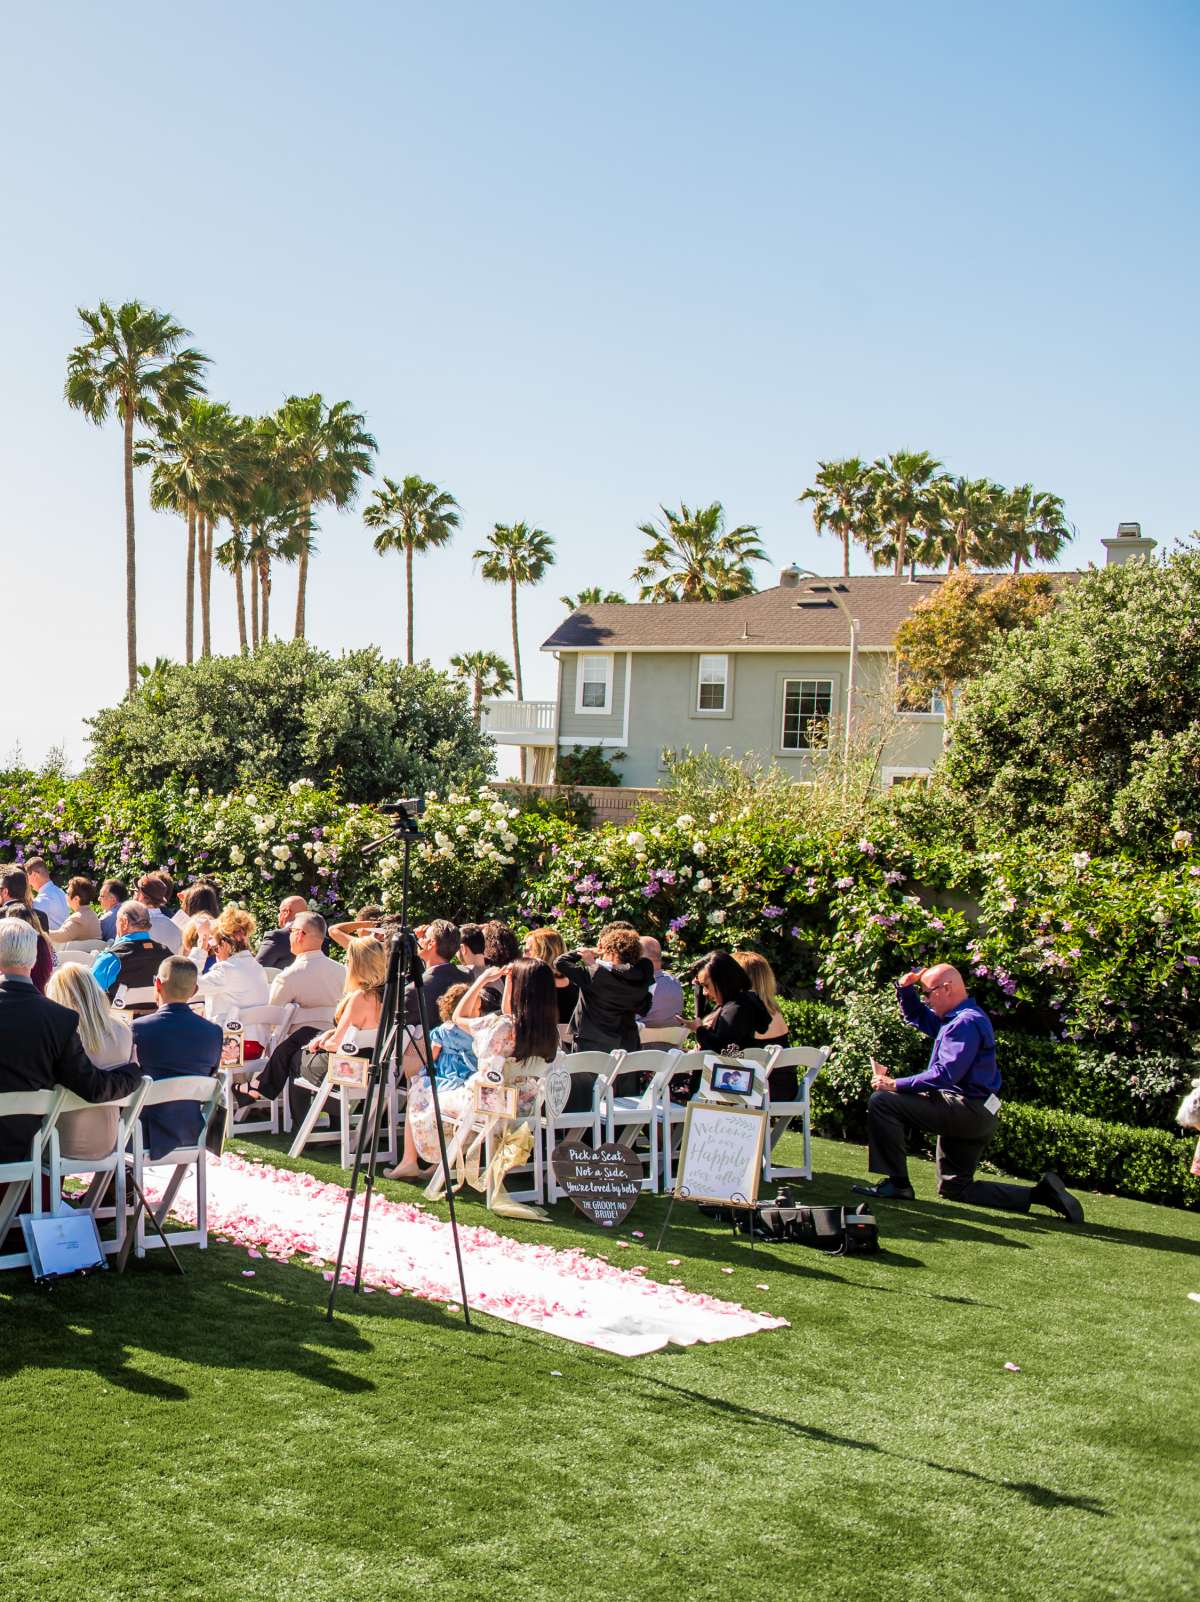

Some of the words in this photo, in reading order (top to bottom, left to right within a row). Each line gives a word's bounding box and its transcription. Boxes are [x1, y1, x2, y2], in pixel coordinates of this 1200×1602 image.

[693, 1118, 752, 1138] Welcome
[569, 1149, 591, 1160] Pick
[601, 1150, 626, 1162] Seat,
[689, 1141, 751, 1177] Happily
[575, 1166, 593, 1177] Not
[604, 1167, 628, 1178] Side,
[566, 1181, 590, 1193] You're
[590, 1181, 611, 1192] loved
[611, 1182, 621, 1197] by
[621, 1183, 638, 1194] both
[582, 1201, 592, 1209] THE
[592, 1201, 617, 1210] GROOM
[594, 1210, 618, 1219] BRIDE!
